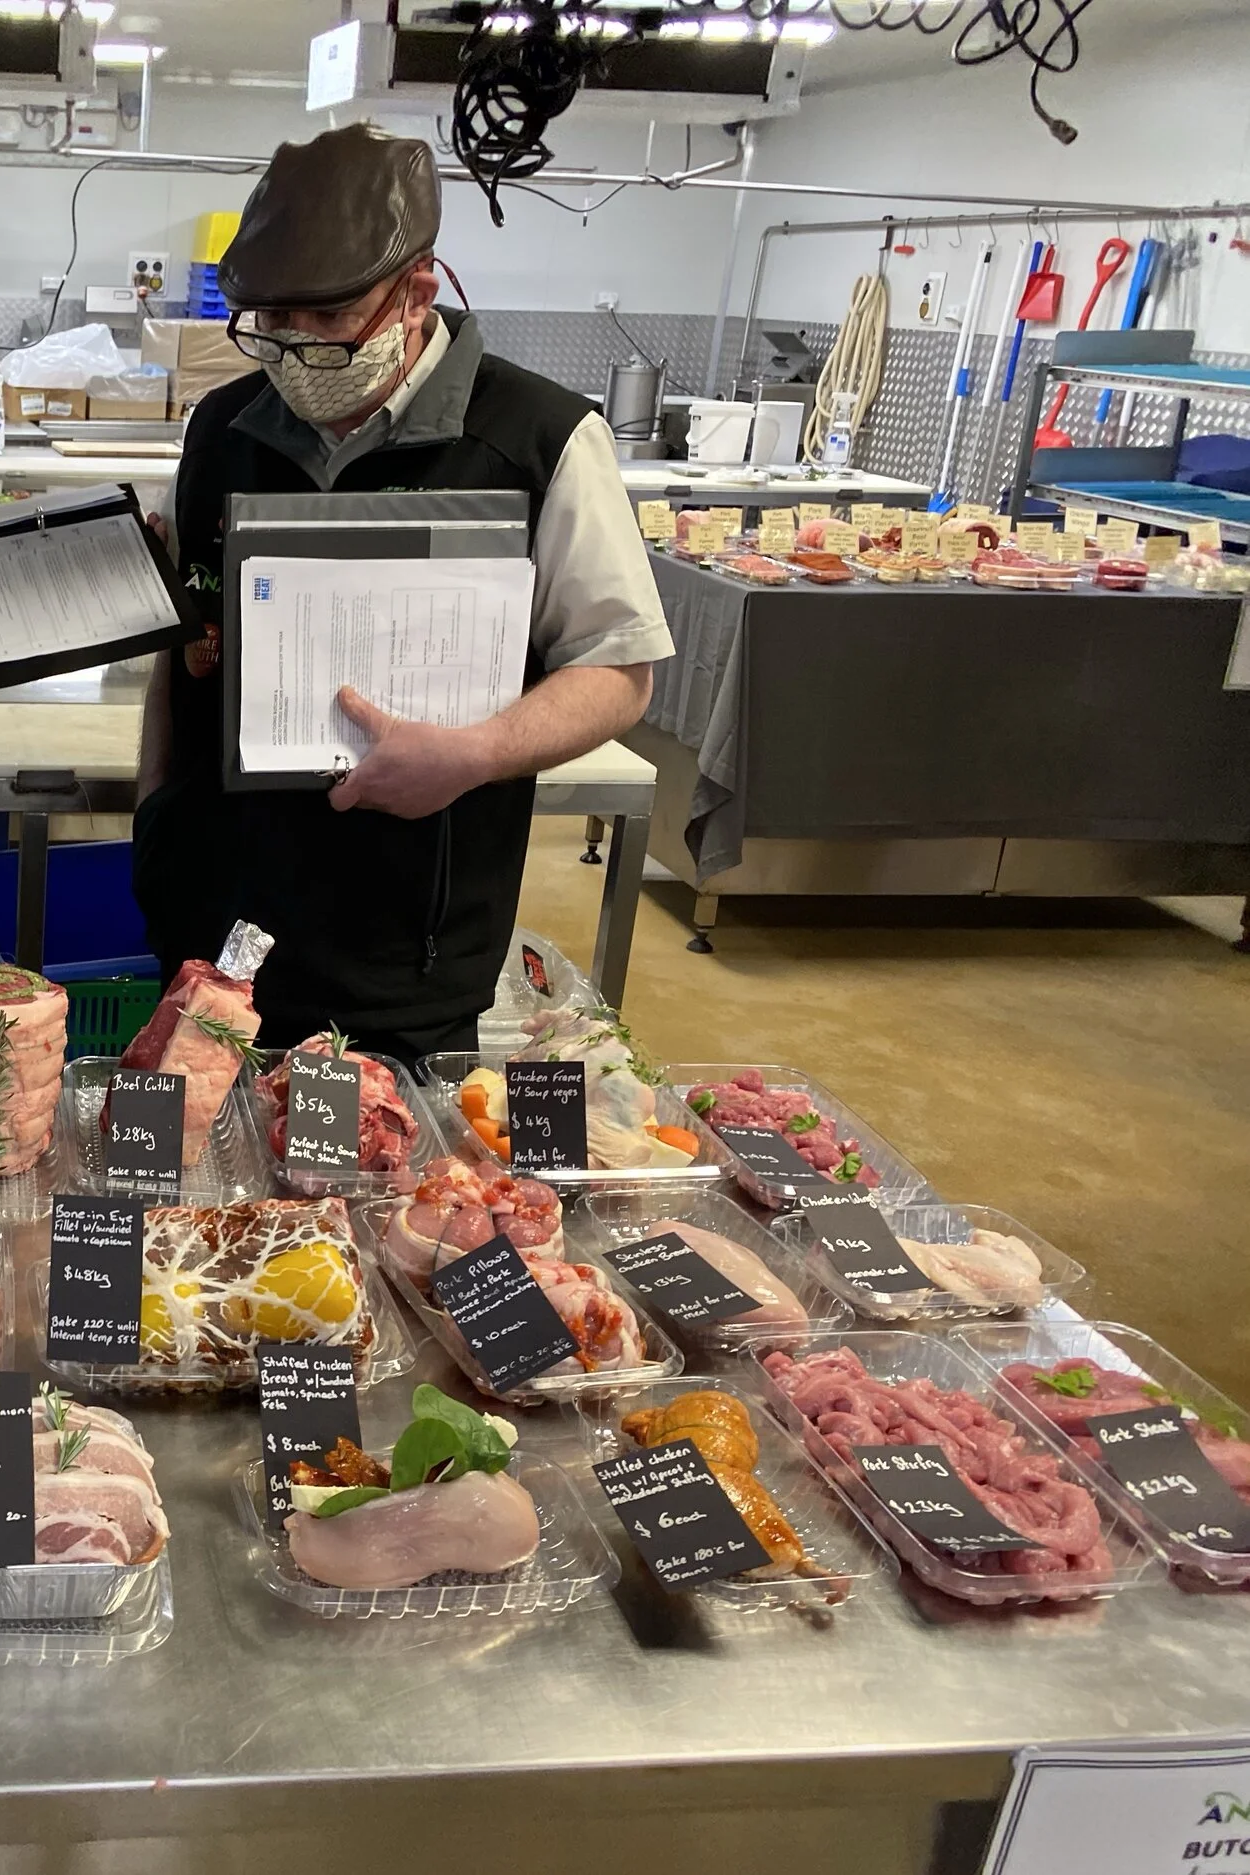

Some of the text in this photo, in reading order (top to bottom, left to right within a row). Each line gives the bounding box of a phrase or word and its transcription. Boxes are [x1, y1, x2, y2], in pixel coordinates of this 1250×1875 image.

[261, 578, 270, 600] MEAT
[292, 1057, 356, 1083] Soup Bones
[510, 1069, 582, 1082] Chicken Frame
[112, 1074, 175, 1092] Beef Cutlet
[509, 1086, 578, 1104] w/ Soup veges
[296, 1090, 336, 1124] $5kg
[291, 1136, 334, 1153] Perfect for
[515, 1147, 566, 1163] Perfect for
[108, 1167, 176, 1179] Bake until
[800, 1194, 849, 1207] Chicken
[54, 1219, 79, 1231] Fillet
[110, 1210, 133, 1226] Eye
[53, 1233, 79, 1243] tomato
[616, 1243, 668, 1262] Skinless
[618, 1245, 694, 1273] Chicken Breast
[63, 1265, 111, 1288] $48kg
[436, 1250, 510, 1291] Pork Pillows
[458, 1267, 512, 1301] Beef Pork
[704, 1296, 720, 1306] for
[51, 1315, 78, 1328] Bake
[117, 1321, 138, 1332] until
[50, 1326, 84, 1341] Internal
[88, 1330, 113, 1346] temp
[262, 1357, 309, 1369] Stuffed
[518, 1354, 534, 1363] for
[261, 1370, 298, 1385] Breast
[262, 1400, 287, 1410] Feta
[1100, 1428, 1134, 1444] Pork
[598, 1459, 644, 1480] Stuffed
[862, 1458, 890, 1471] Pork
[655, 1556, 687, 1573] Bake
[728, 1540, 745, 1551] for
